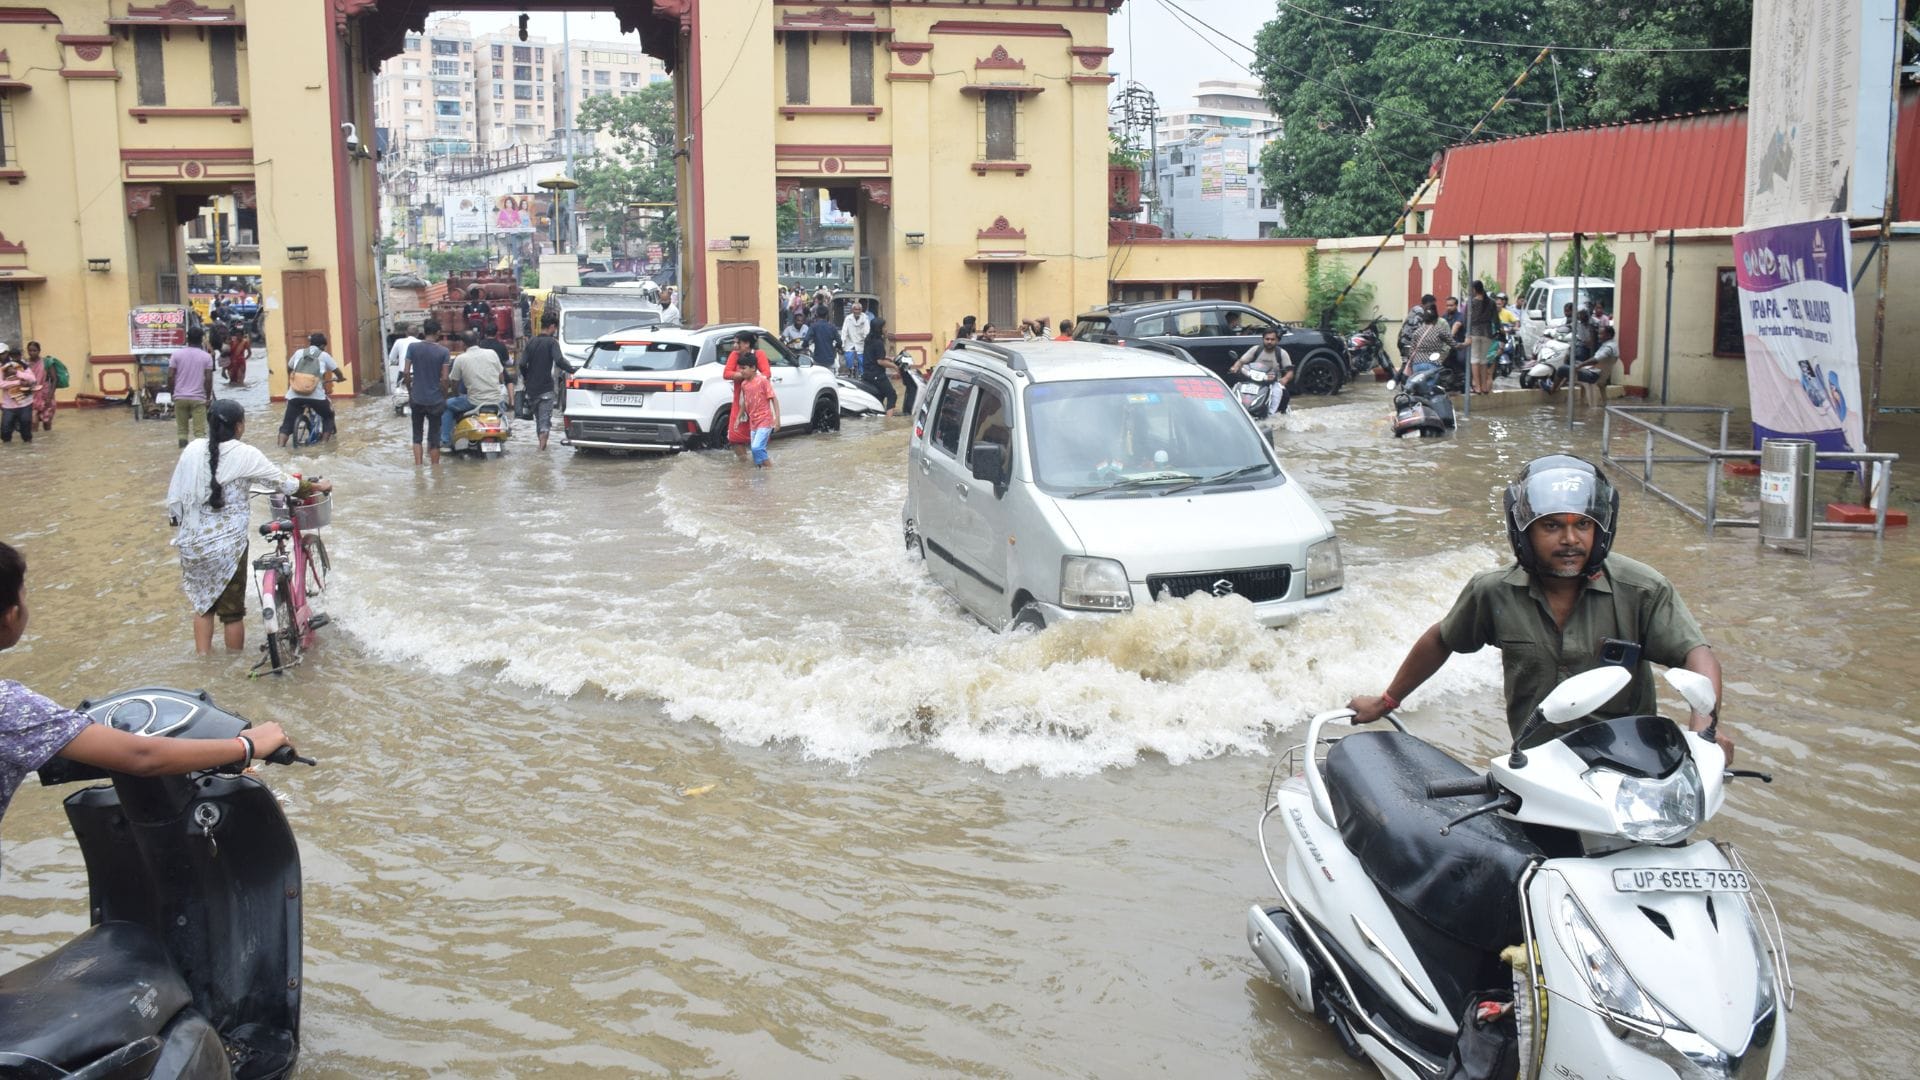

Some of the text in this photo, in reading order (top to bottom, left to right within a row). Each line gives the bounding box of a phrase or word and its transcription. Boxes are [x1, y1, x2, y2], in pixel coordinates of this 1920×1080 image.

[1551, 481, 1580, 492] TVS
[1633, 871, 1655, 889] UP
[1661, 871, 1702, 889] 65EE
[1706, 872, 1748, 889] 7833
